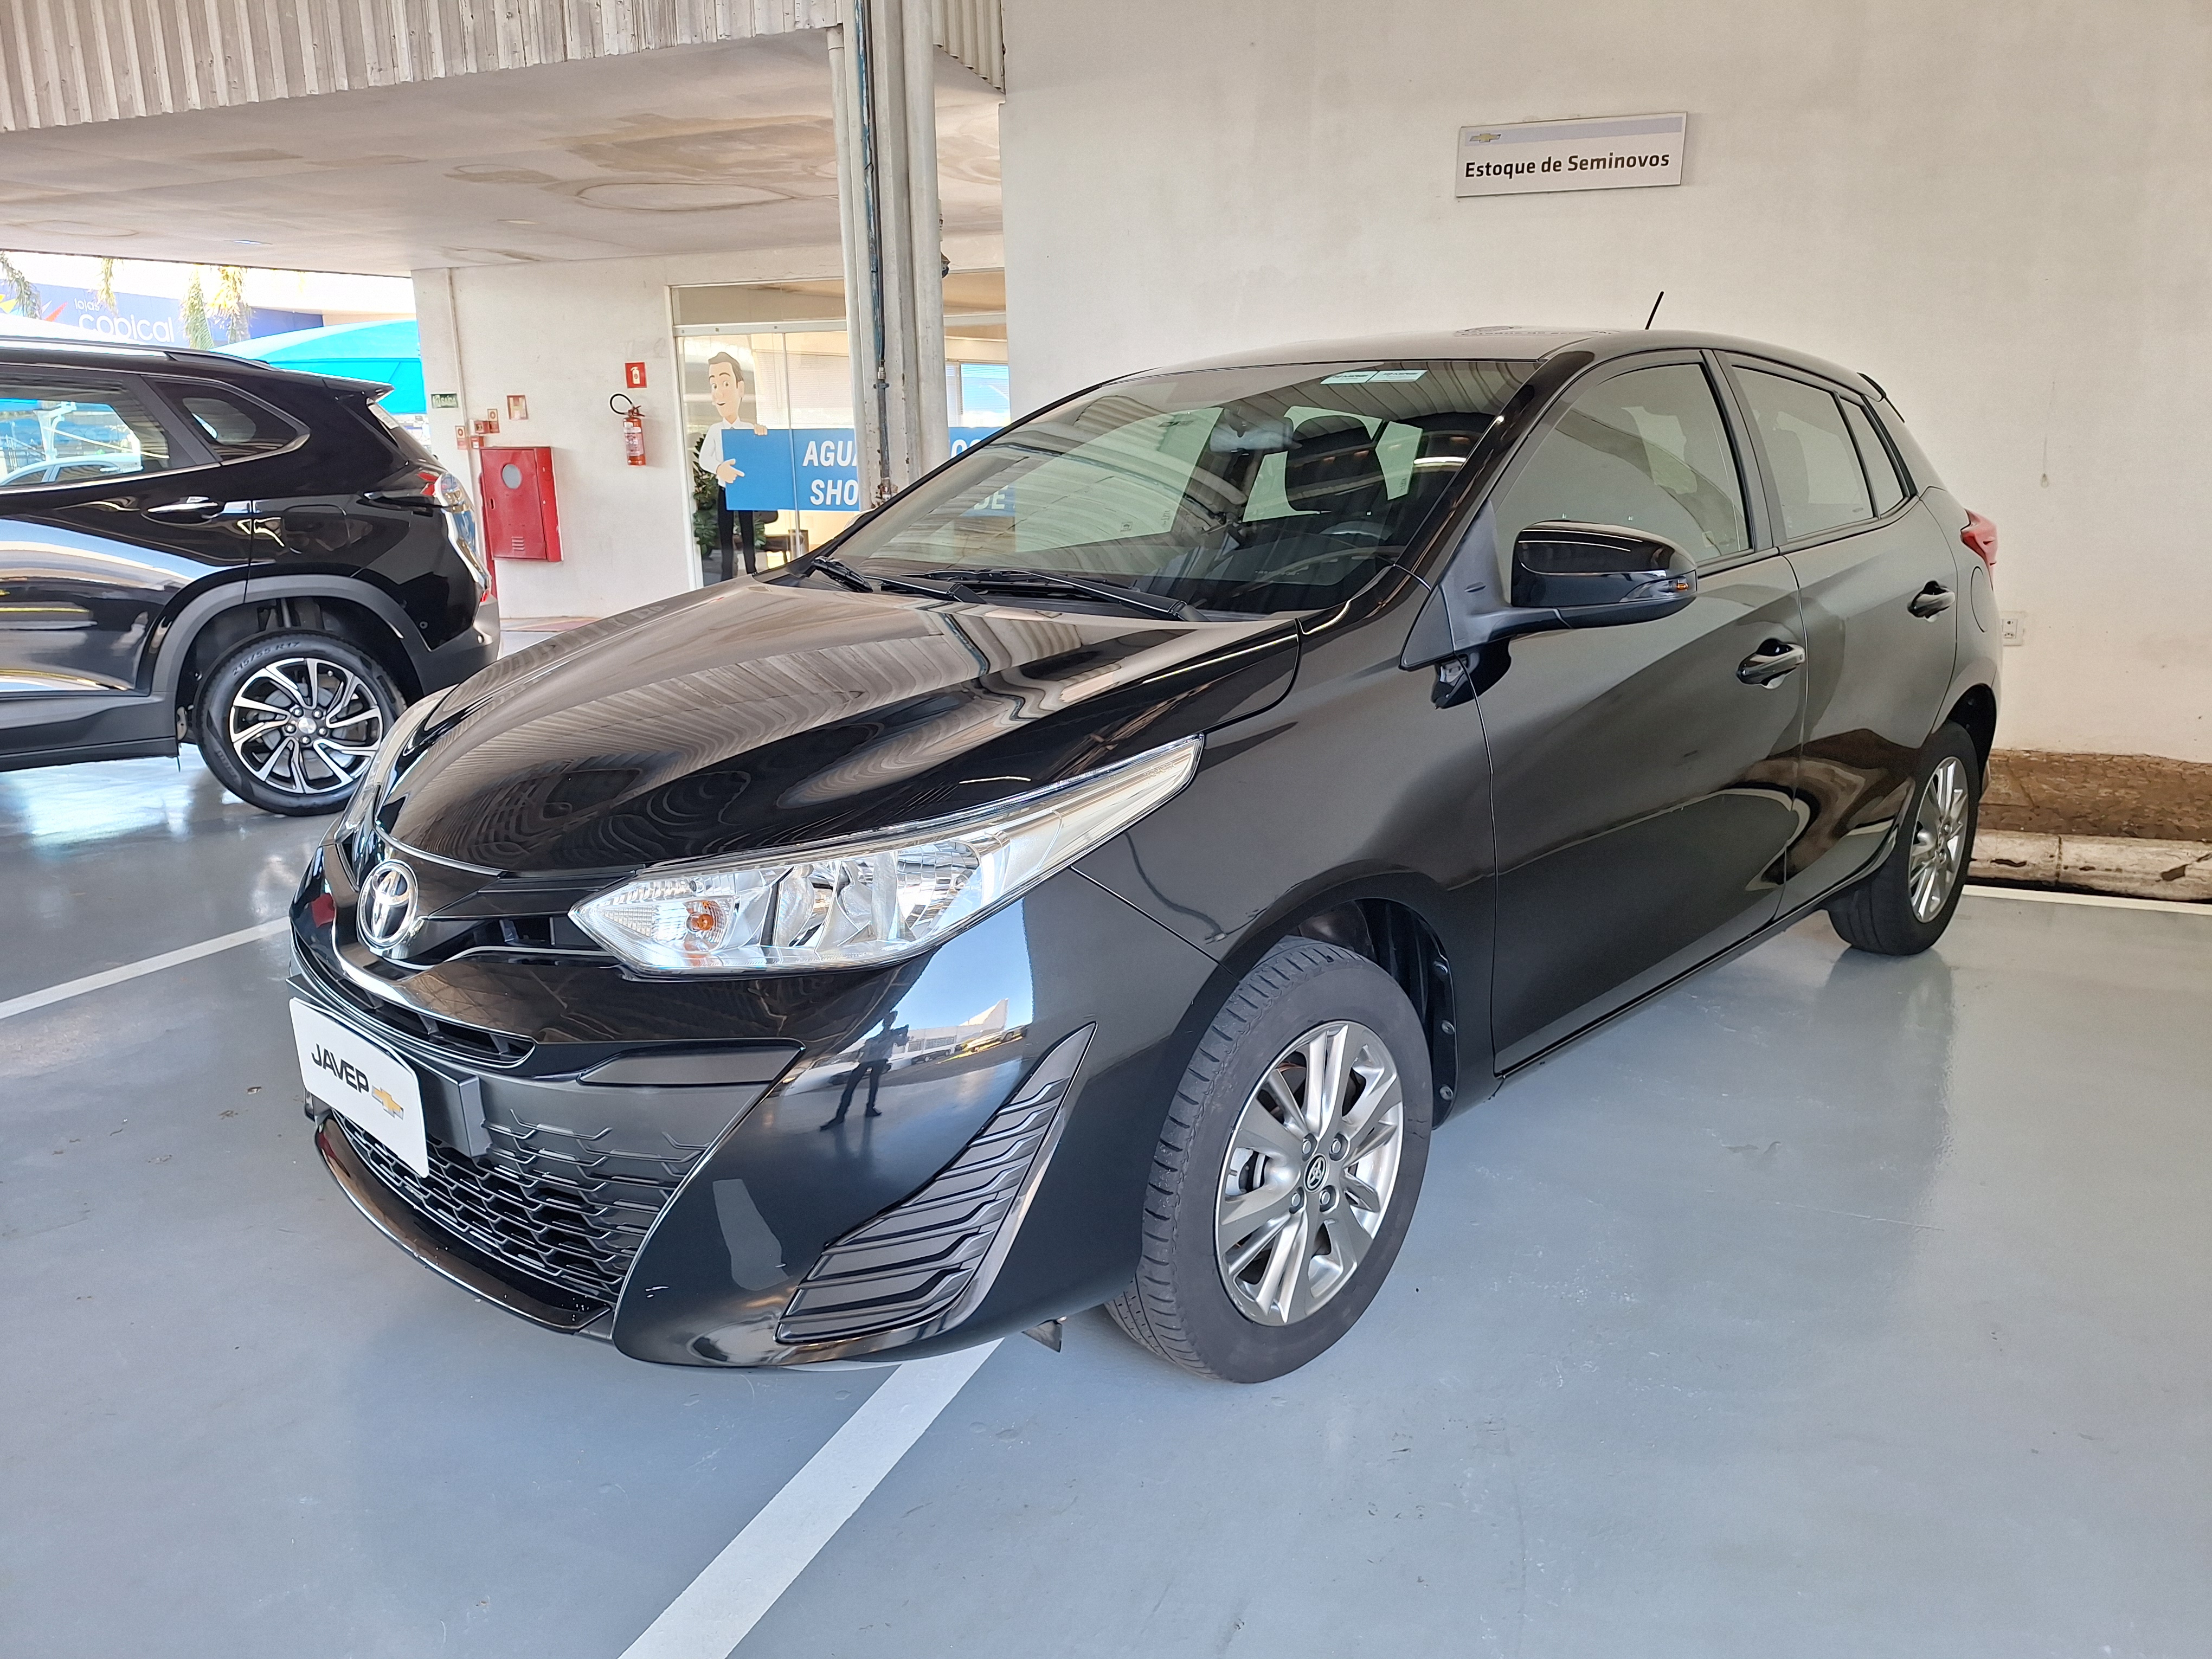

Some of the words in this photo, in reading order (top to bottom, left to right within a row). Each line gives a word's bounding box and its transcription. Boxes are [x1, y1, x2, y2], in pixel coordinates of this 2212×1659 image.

[1465, 162, 1536, 179] Estoque
[1541, 156, 1562, 173] de
[1567, 152, 1670, 171] Seminovos
[74, 298, 100, 312] lojas
[802, 440, 857, 467] AGU
[311, 1043, 369, 1094] JAVEP
